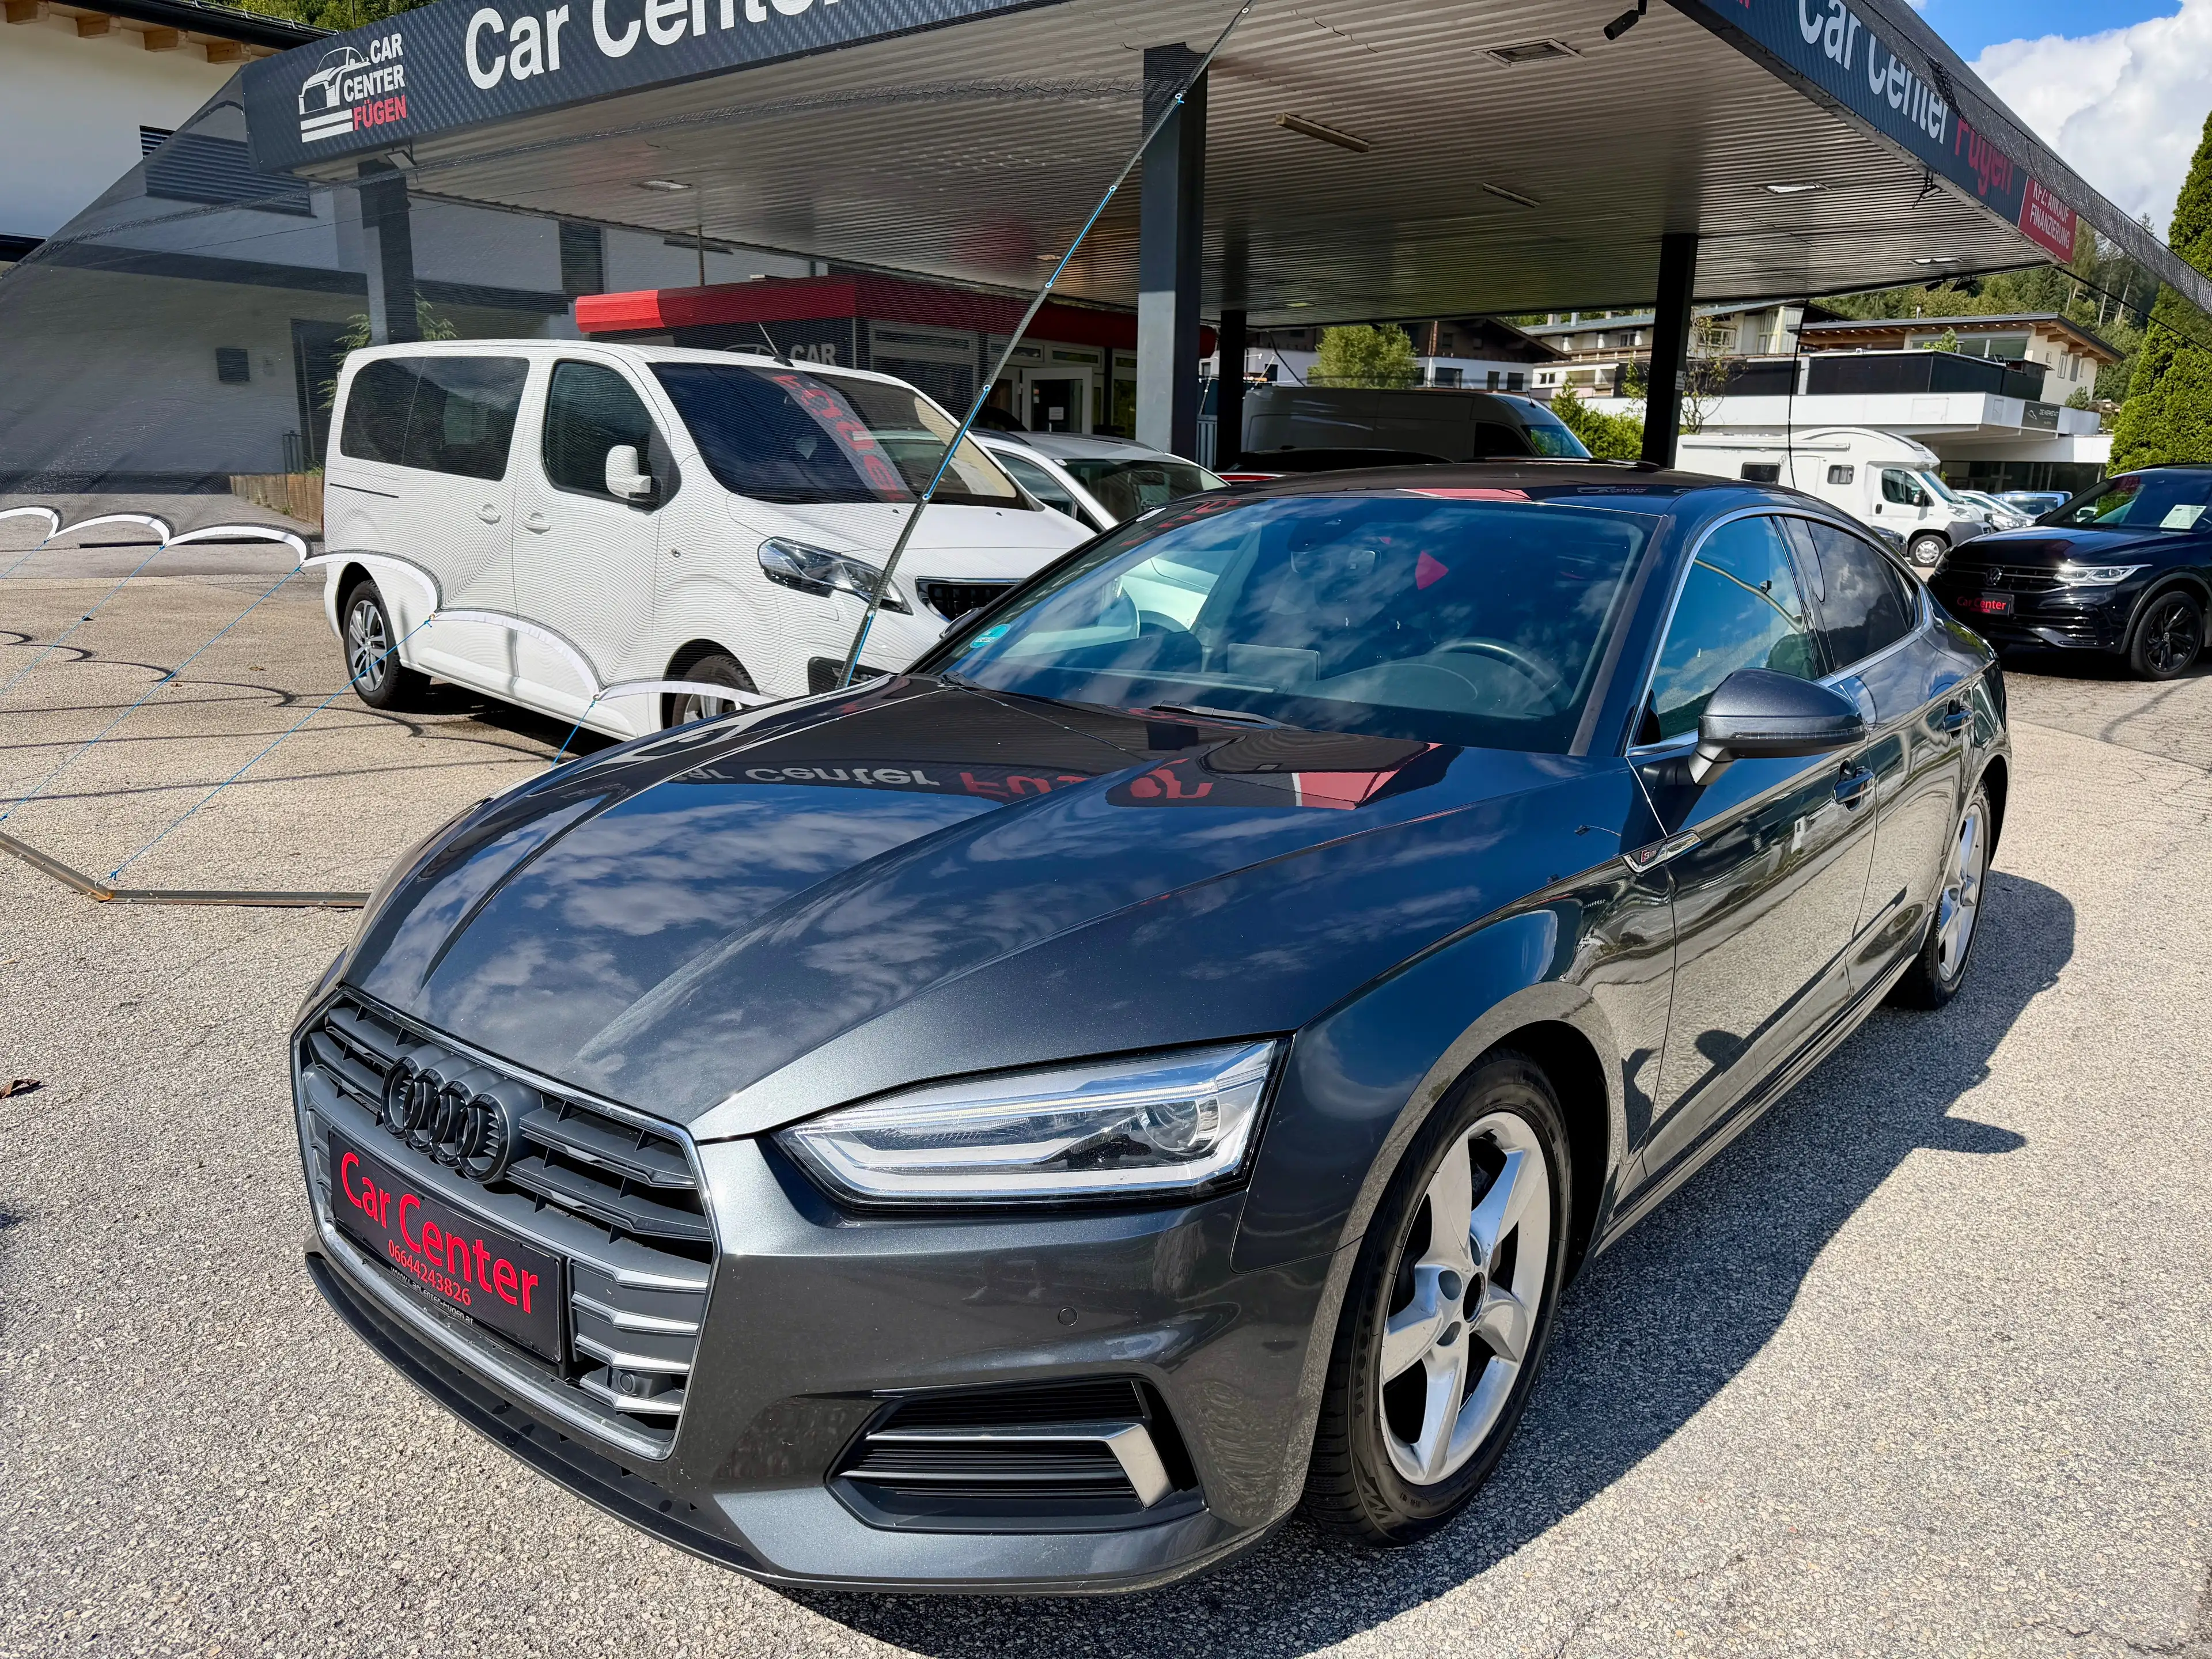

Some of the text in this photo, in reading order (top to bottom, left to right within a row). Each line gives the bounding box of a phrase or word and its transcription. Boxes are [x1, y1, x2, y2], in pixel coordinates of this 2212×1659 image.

[370, 33, 403, 63] CAR
[465, 3, 569, 89] Car
[343, 65, 406, 102] CENTER
[354, 94, 407, 130] FÜGEN
[2029, 203, 2070, 249] FINANZIERUNG
[2047, 193, 2070, 224] ANKAUF
[790, 343, 836, 366] CAR
[1974, 598, 2006, 610] Center
[341, 1152, 539, 1314] Car Center
[388, 1240, 472, 1306] 06644243826
